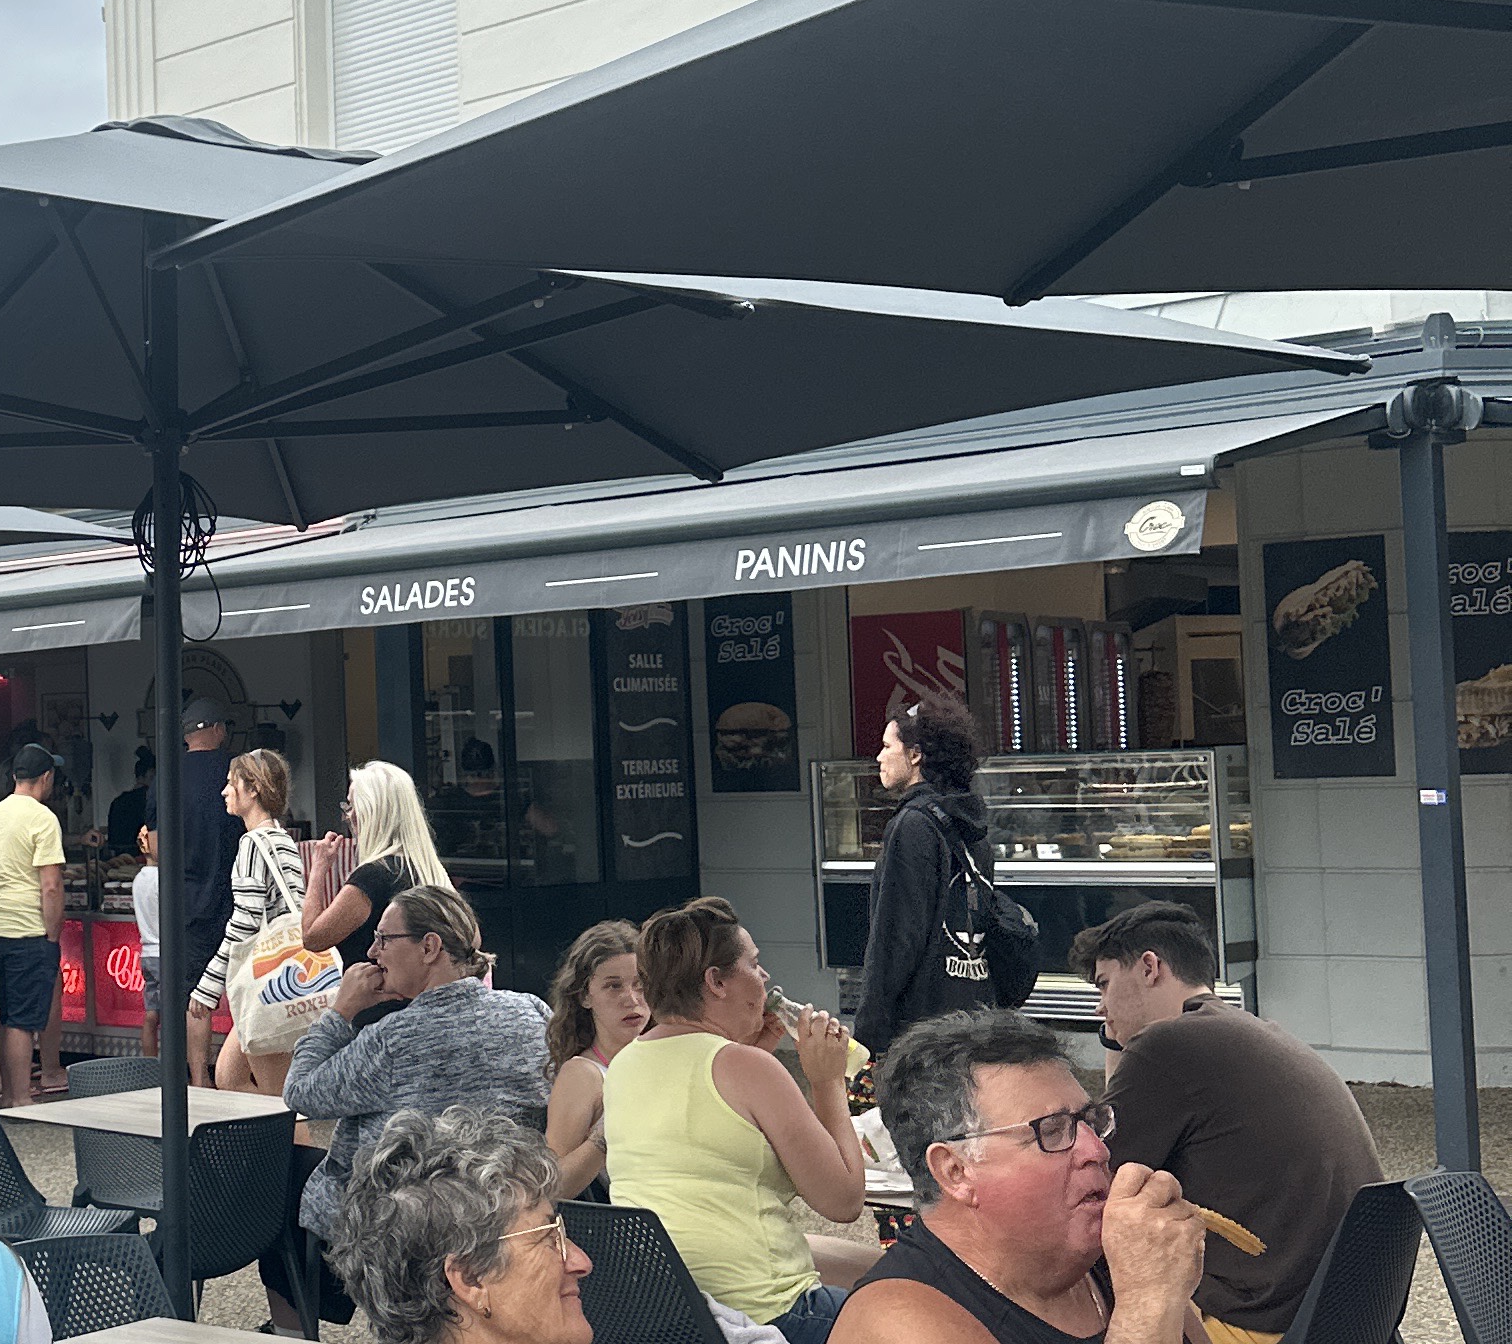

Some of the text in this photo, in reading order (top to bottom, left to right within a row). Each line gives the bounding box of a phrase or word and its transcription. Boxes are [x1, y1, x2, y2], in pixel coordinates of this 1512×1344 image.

[734, 538, 866, 581] PANINIS
[359, 576, 476, 615] SALADES
[1450, 585, 1512, 616] alé
[711, 611, 784, 637] Croc'
[629, 654, 663, 668] SALLE
[717, 634, 781, 663] Salé
[613, 674, 678, 692] CLIMATISÉE
[1281, 686, 1382, 714] Croc'
[1290, 714, 1377, 746] Salé
[621, 759, 679, 775] TERRASSE
[616, 781, 684, 800] EXTÉRIEURE
[285, 994, 328, 1018] ROXY
